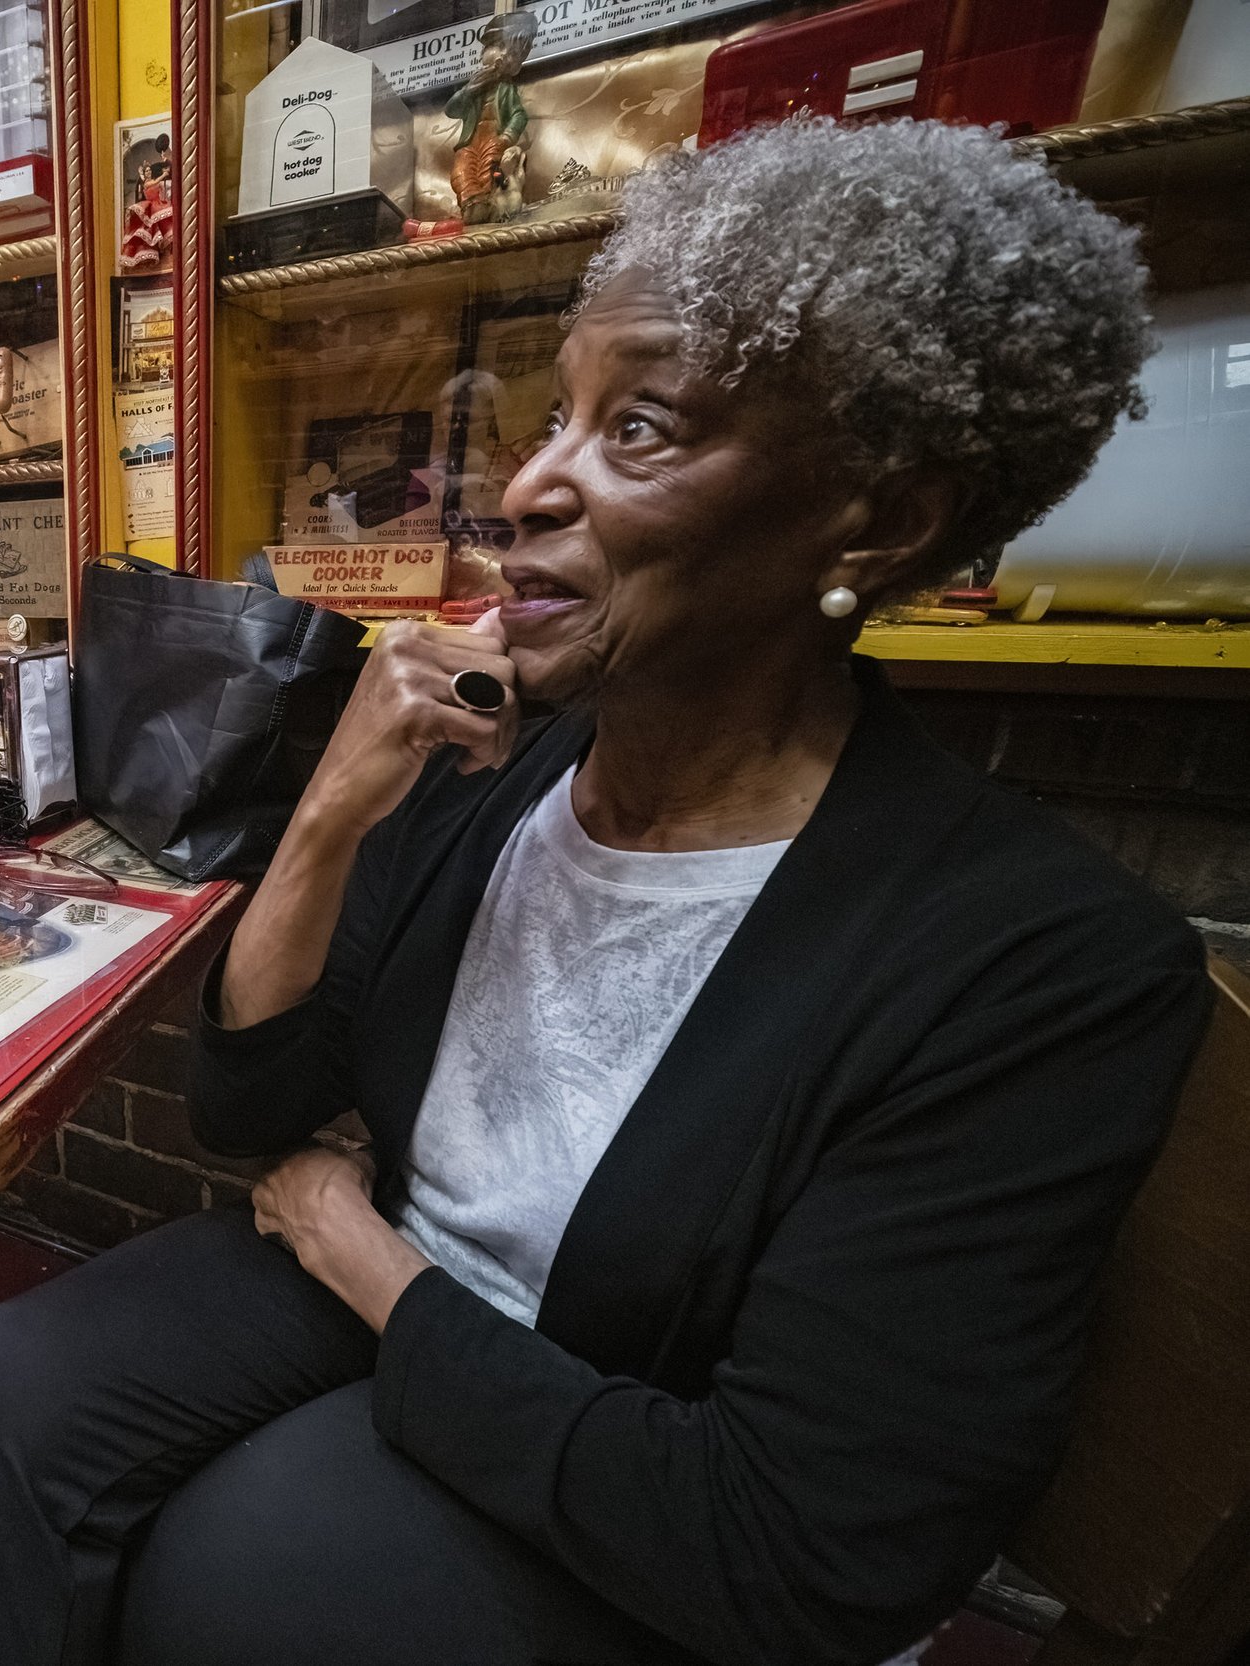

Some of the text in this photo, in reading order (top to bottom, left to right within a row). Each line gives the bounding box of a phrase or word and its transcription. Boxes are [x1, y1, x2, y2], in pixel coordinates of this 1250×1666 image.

[407, 72, 430, 86] passes
[434, 62, 466, 75] through
[542, 34, 569, 46] shown
[574, 30, 583, 38] in
[588, 25, 603, 34] the
[608, 16, 635, 29] inside
[641, 10, 661, 20] view
[666, 5, 675, 14] at
[409, 58, 445, 72] invention
[450, 50, 464, 61] and
[551, 22, 577, 33] comes
[422, 76, 451, 87] without
[282, 89, 333, 109] Deli-Dog
[284, 156, 322, 171] hot dog
[284, 167, 320, 181] cooker
[121, 406, 153, 417] HALLS
[307, 515, 333, 524] COOKS
[400, 518, 440, 528] DELICIOUS
[377, 527, 440, 537] ROASTED FLAVOR
[274, 549, 434, 565] ELECTRIC HOT DOG
[312, 566, 384, 581] COOKER
[9, 583, 29, 593] Hot
[34, 583, 61, 593] Dogs
[303, 583, 399, 594] Ideal for Quick Snacks
